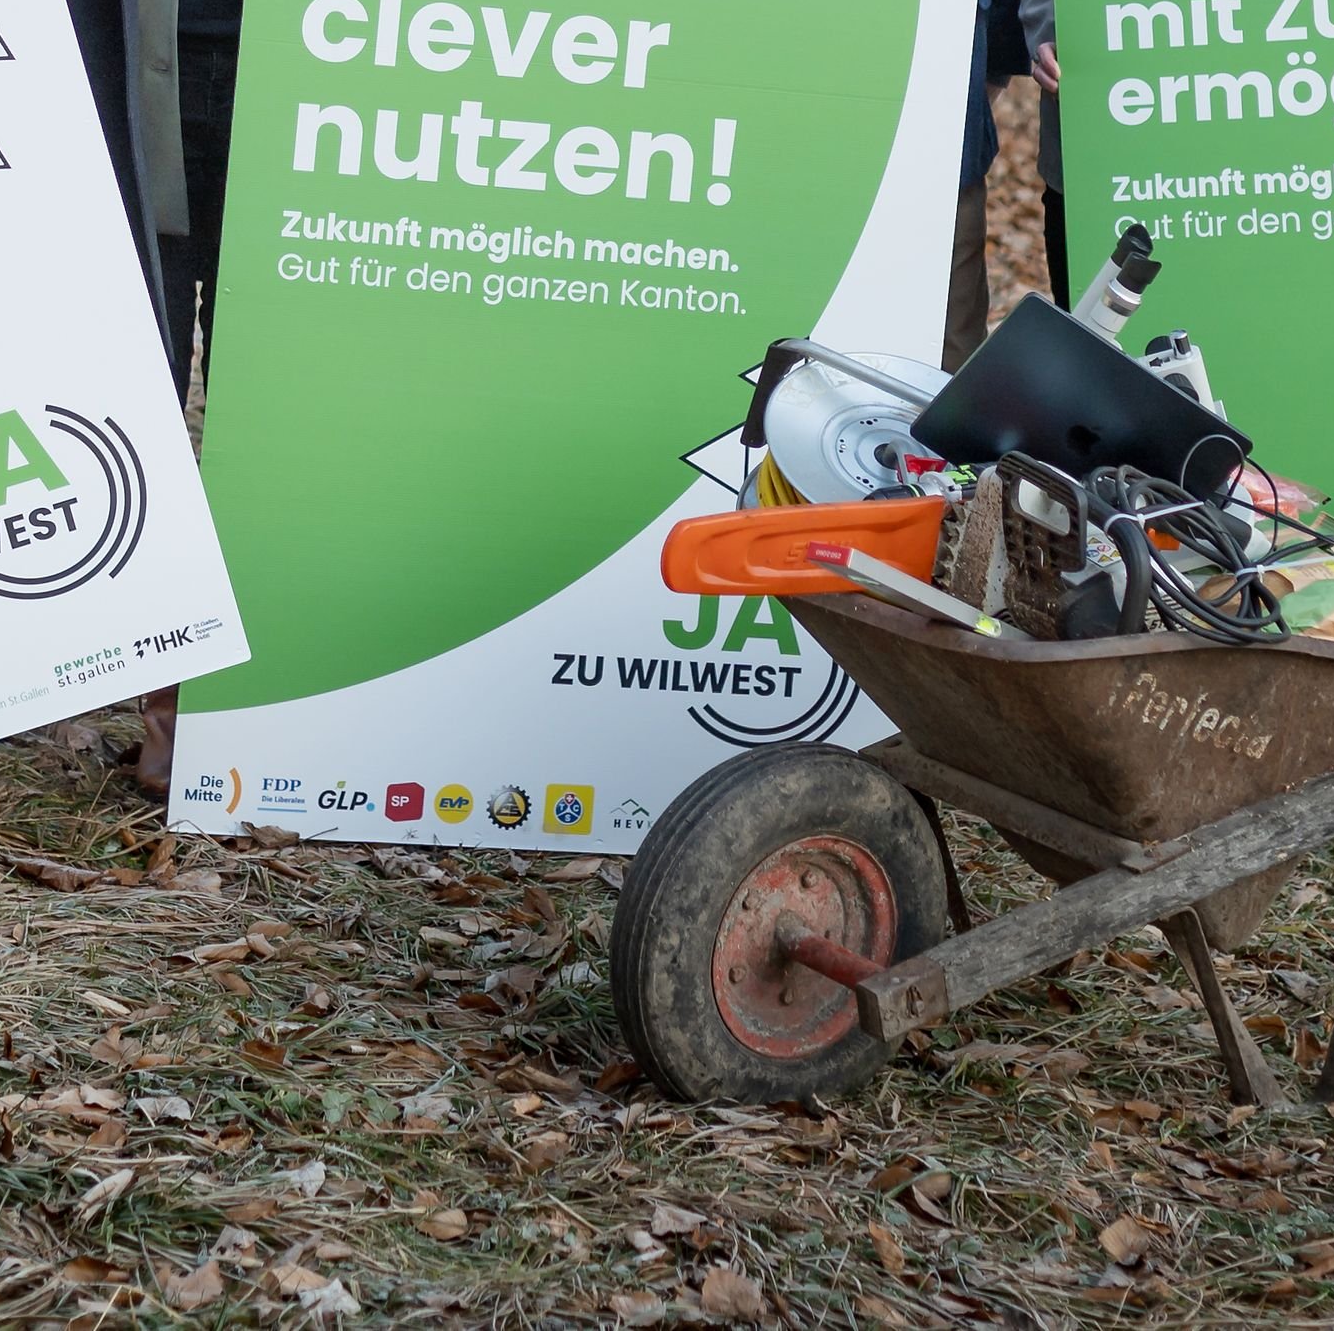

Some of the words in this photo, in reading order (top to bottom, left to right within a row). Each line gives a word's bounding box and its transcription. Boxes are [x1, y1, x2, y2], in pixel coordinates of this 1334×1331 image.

[292, 100, 738, 207] nutzen!
[1112, 167, 1246, 203] Zukunft
[1181, 210, 1228, 238] für
[1237, 207, 1302, 236] den
[280, 209, 423, 248] Zukunft
[429, 222, 576, 264] möglich
[583, 235, 740, 273] machen.
[277, 252, 340, 285] Gut
[349, 257, 397, 288] für
[405, 262, 473, 294] den
[482, 274, 610, 306] ganzen
[619, 279, 747, 315] Kanton.
[153, 625, 194, 654] IHK
[663, 594, 801, 656] JA
[54, 646, 122, 677] gewerbe
[57, 659, 126, 688] st.gallen
[551, 653, 604, 687] ZU
[616, 656, 802, 698] WILWEST
[184, 788, 223, 802] Mitte
[200, 775, 224, 788] Die
[262, 778, 302, 792] FDP
[261, 795, 272, 803] Die
[391, 795, 410, 807] SP
[439, 797, 469, 809] EVP
